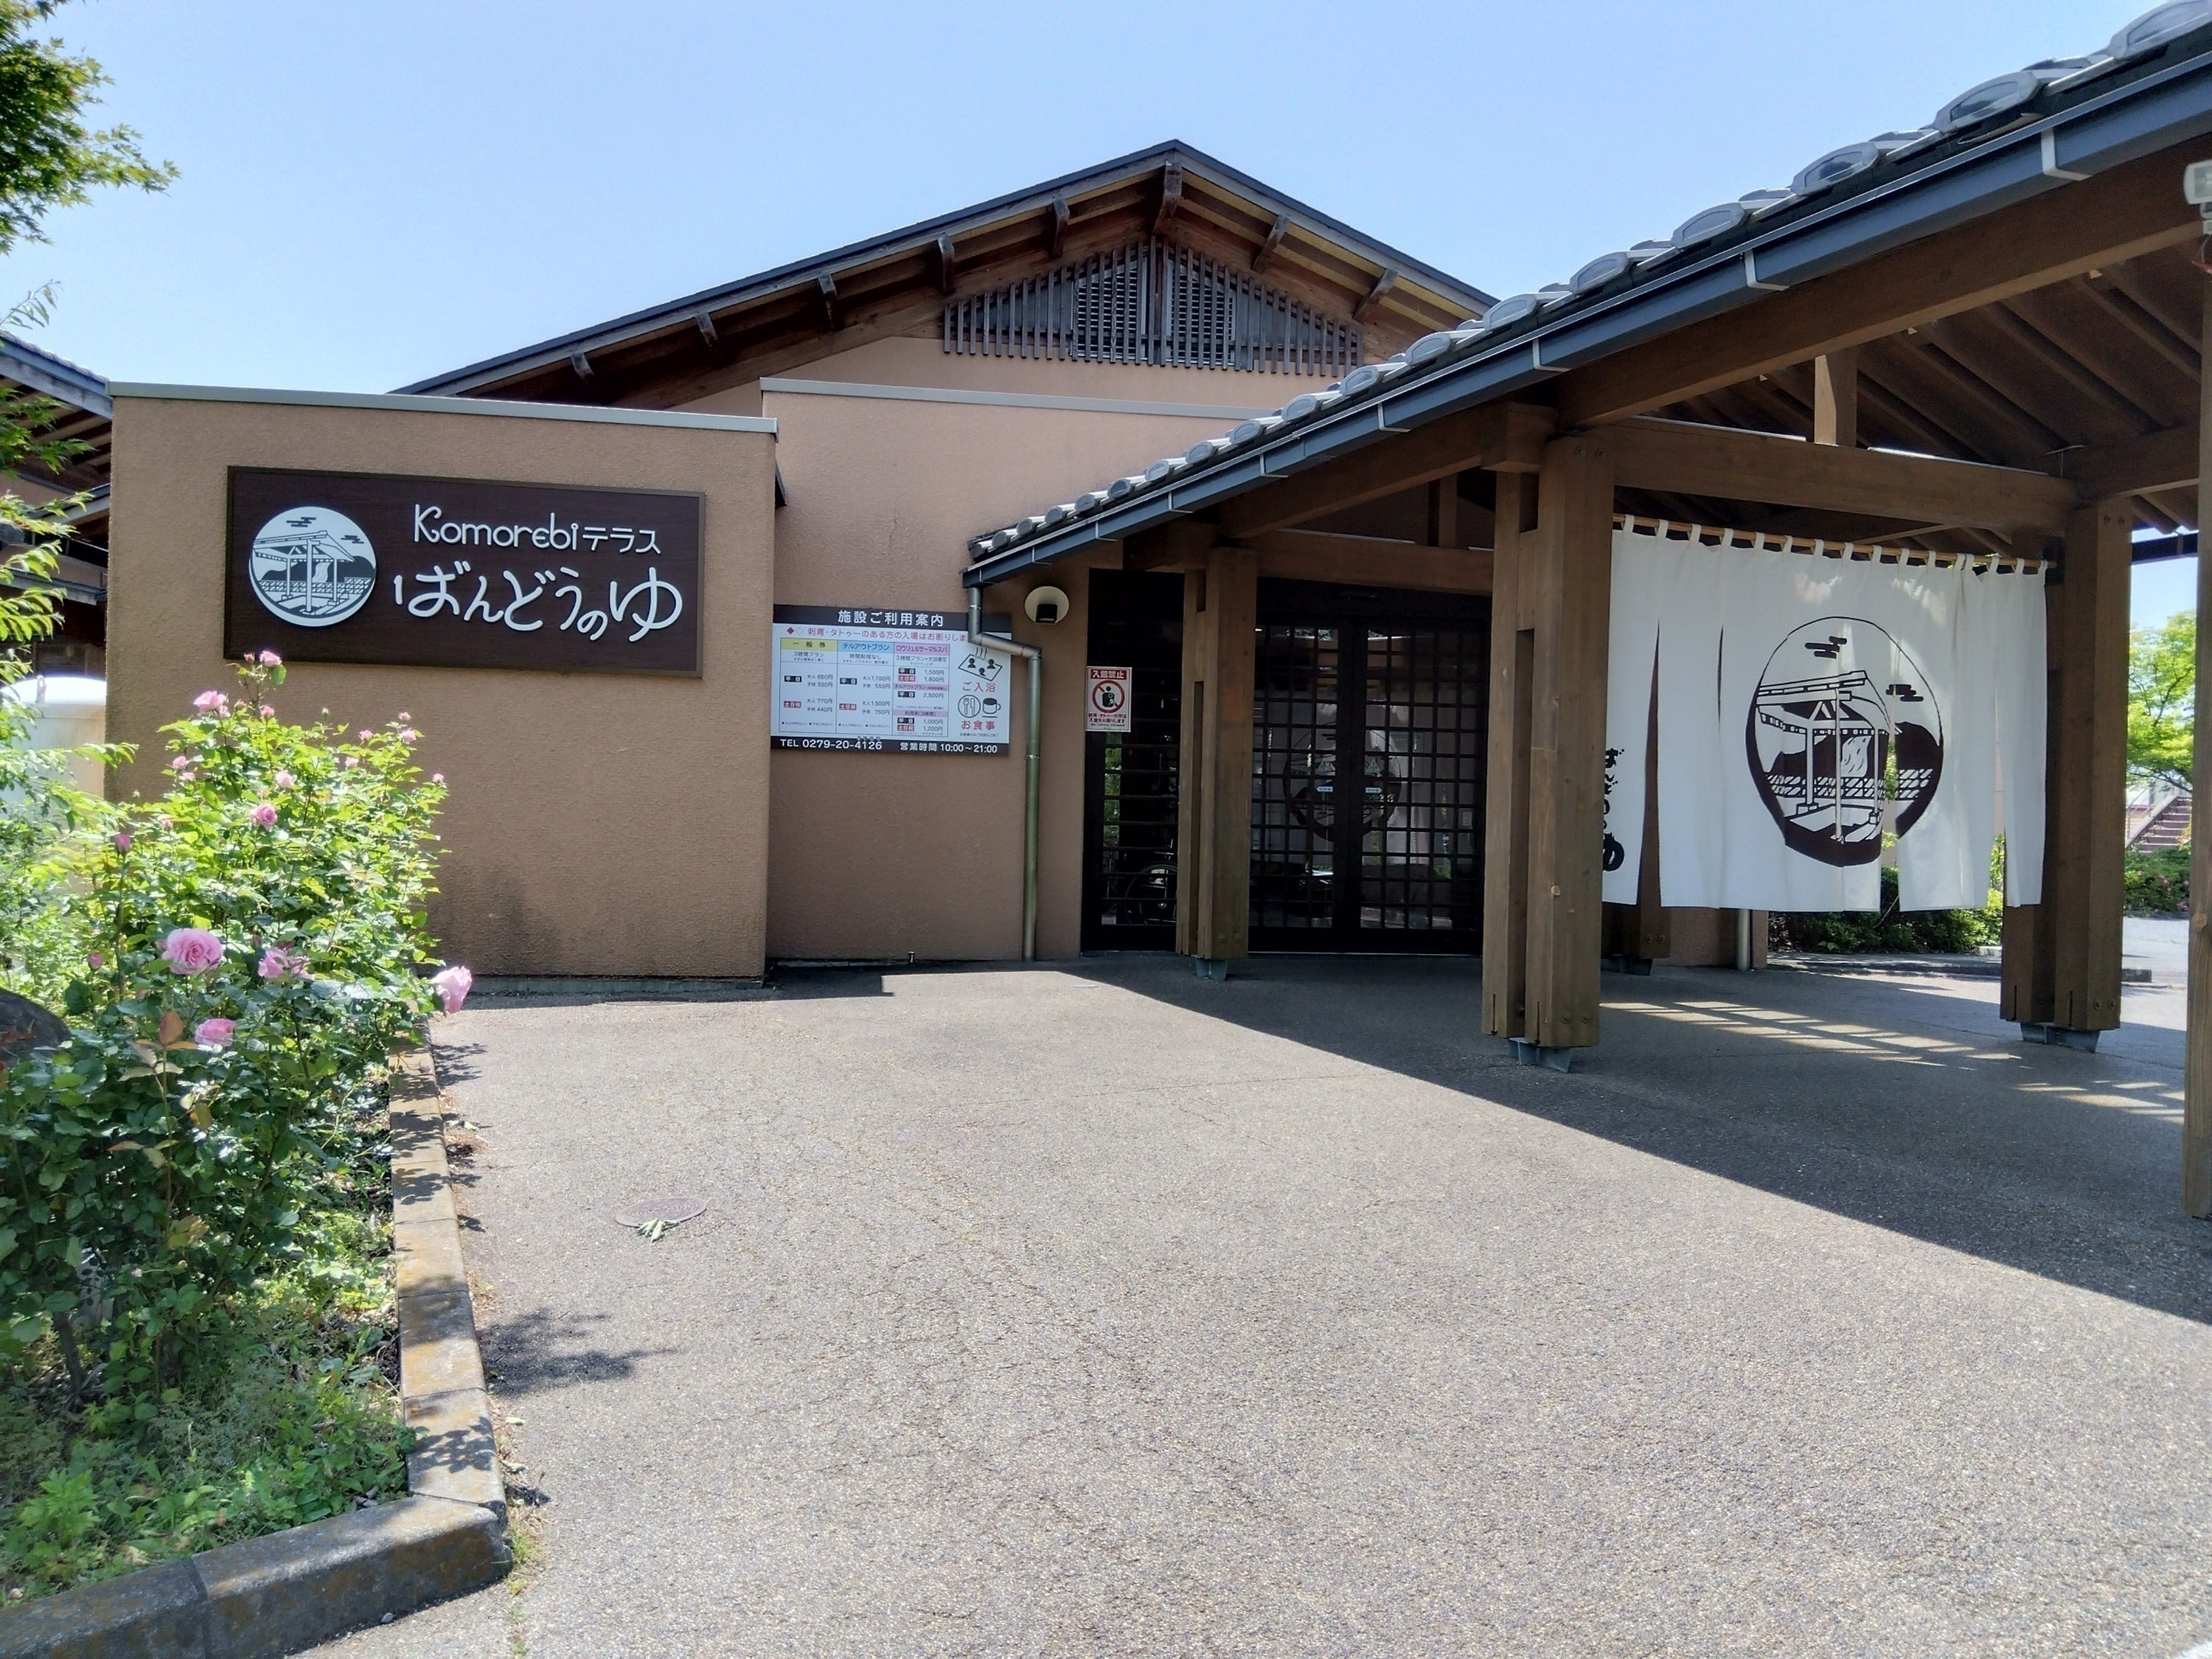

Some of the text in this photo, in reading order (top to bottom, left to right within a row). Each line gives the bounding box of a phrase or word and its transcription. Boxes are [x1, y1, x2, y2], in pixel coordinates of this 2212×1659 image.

[414, 504, 661, 554] Komorebiテラス
[394, 560, 684, 642] ばんどうのゆ
[838, 610, 943, 627] 施設ご利用案内
[843, 642, 890, 650] チルアウトプラン
[1092, 670, 1124, 678] 入館禁止
[962, 681, 996, 692] ご入浴
[961, 720, 995, 731] お食事
[780, 739, 883, 750] TEL 0279-20-4126
[900, 742, 937, 751] 営業時間
